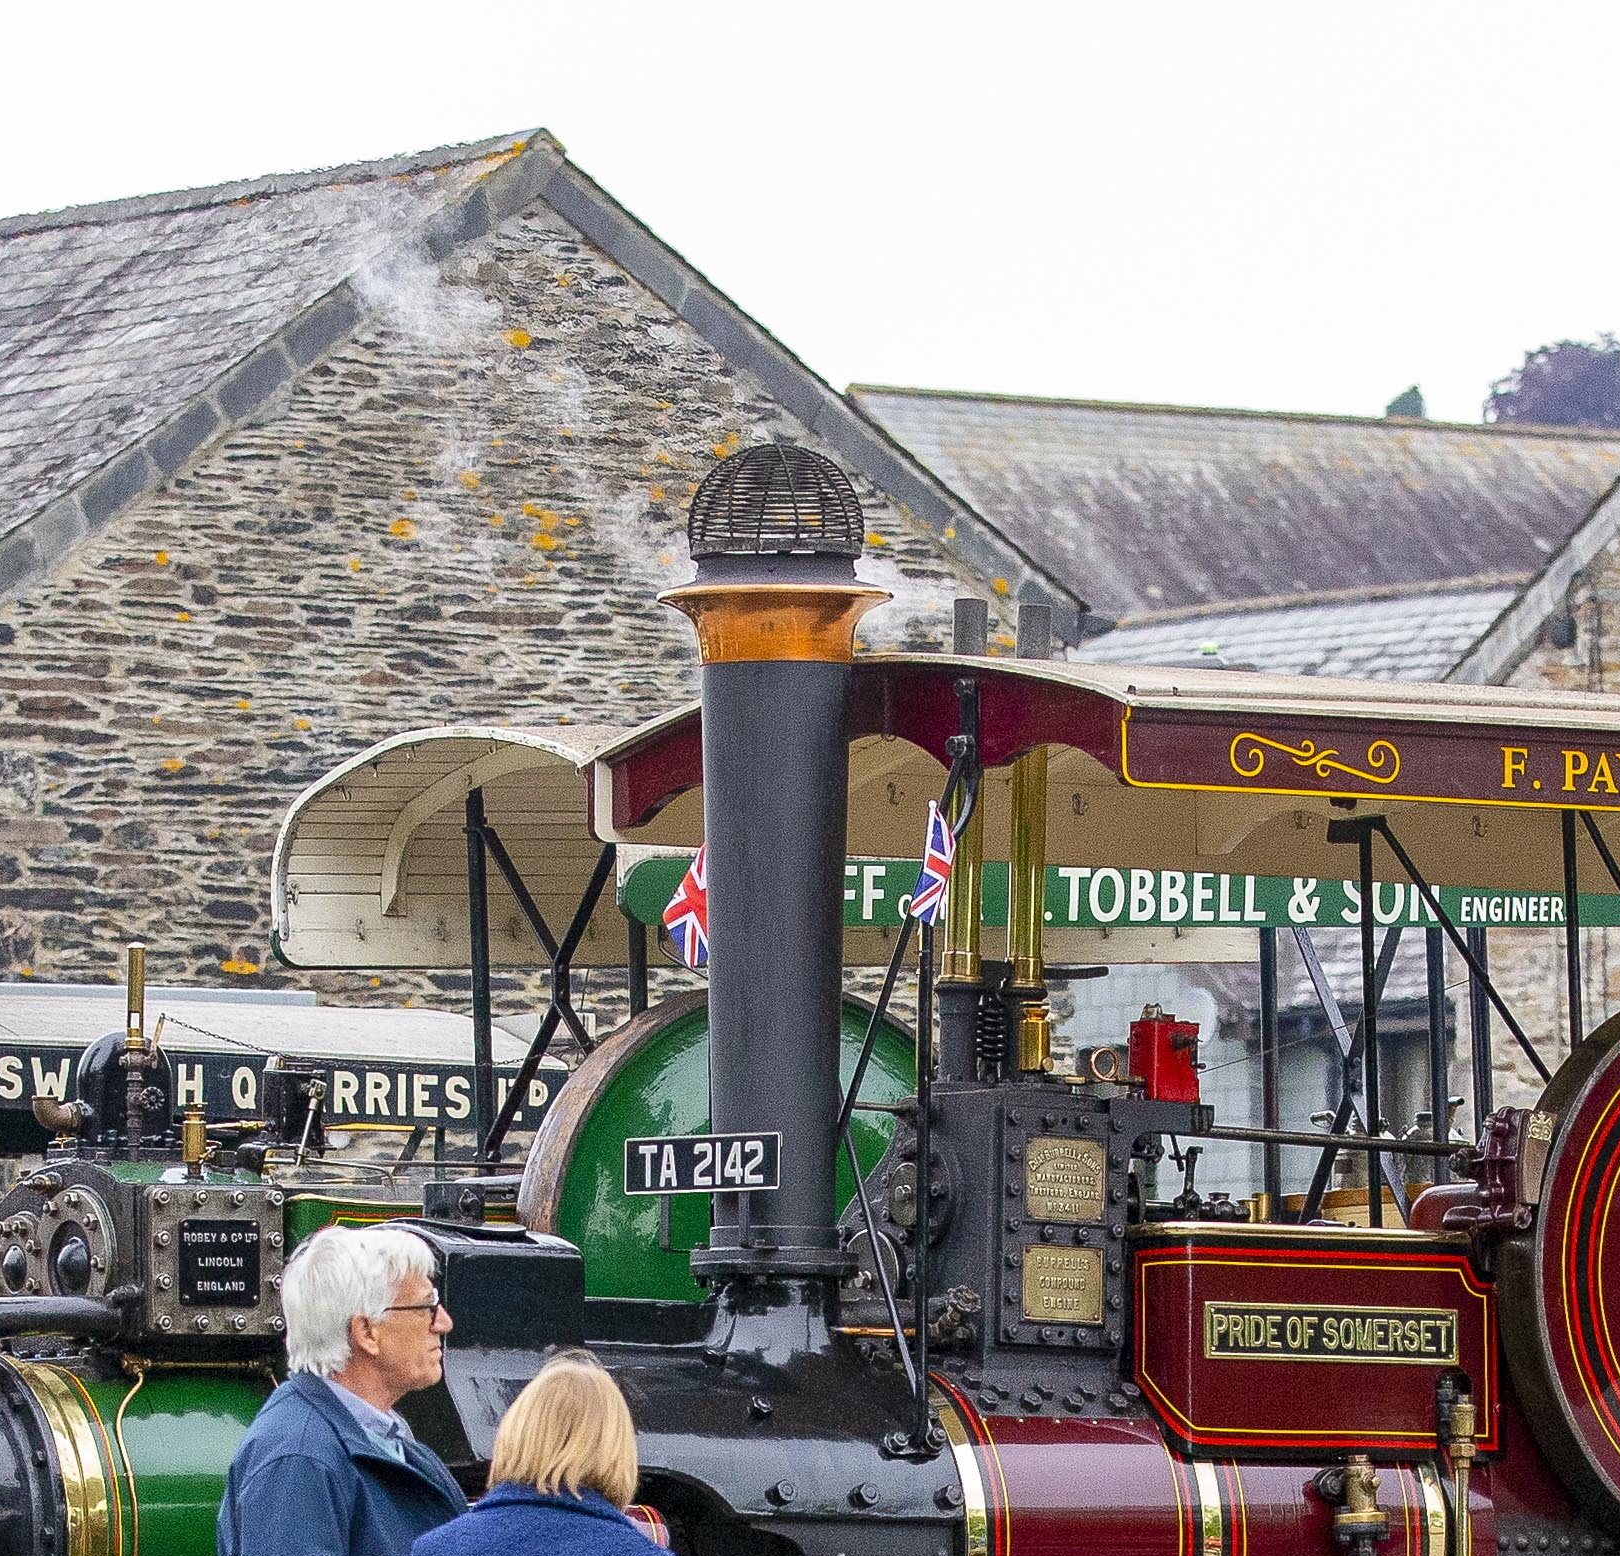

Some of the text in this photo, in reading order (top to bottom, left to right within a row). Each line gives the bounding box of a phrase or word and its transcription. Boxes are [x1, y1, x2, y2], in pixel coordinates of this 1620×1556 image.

[1500, 745, 1541, 790] F.
[1288, 877, 1322, 924] &
[1460, 896, 1566, 923] ENGINEER
[231, 1065, 472, 1119] QRRIES
[638, 1140, 765, 1188] TA 2142
[183, 1232, 217, 1243] ROBEY
[220, 1232, 228, 1243] &
[197, 1257, 244, 1268] LINCOLN
[197, 1281, 246, 1292] ENGLAND
[1039, 1275, 1086, 1291] COMPOUND
[1042, 1295, 1081, 1311] ENGINE
[1212, 1314, 1453, 1354] PRIDE OF SOMERSET
